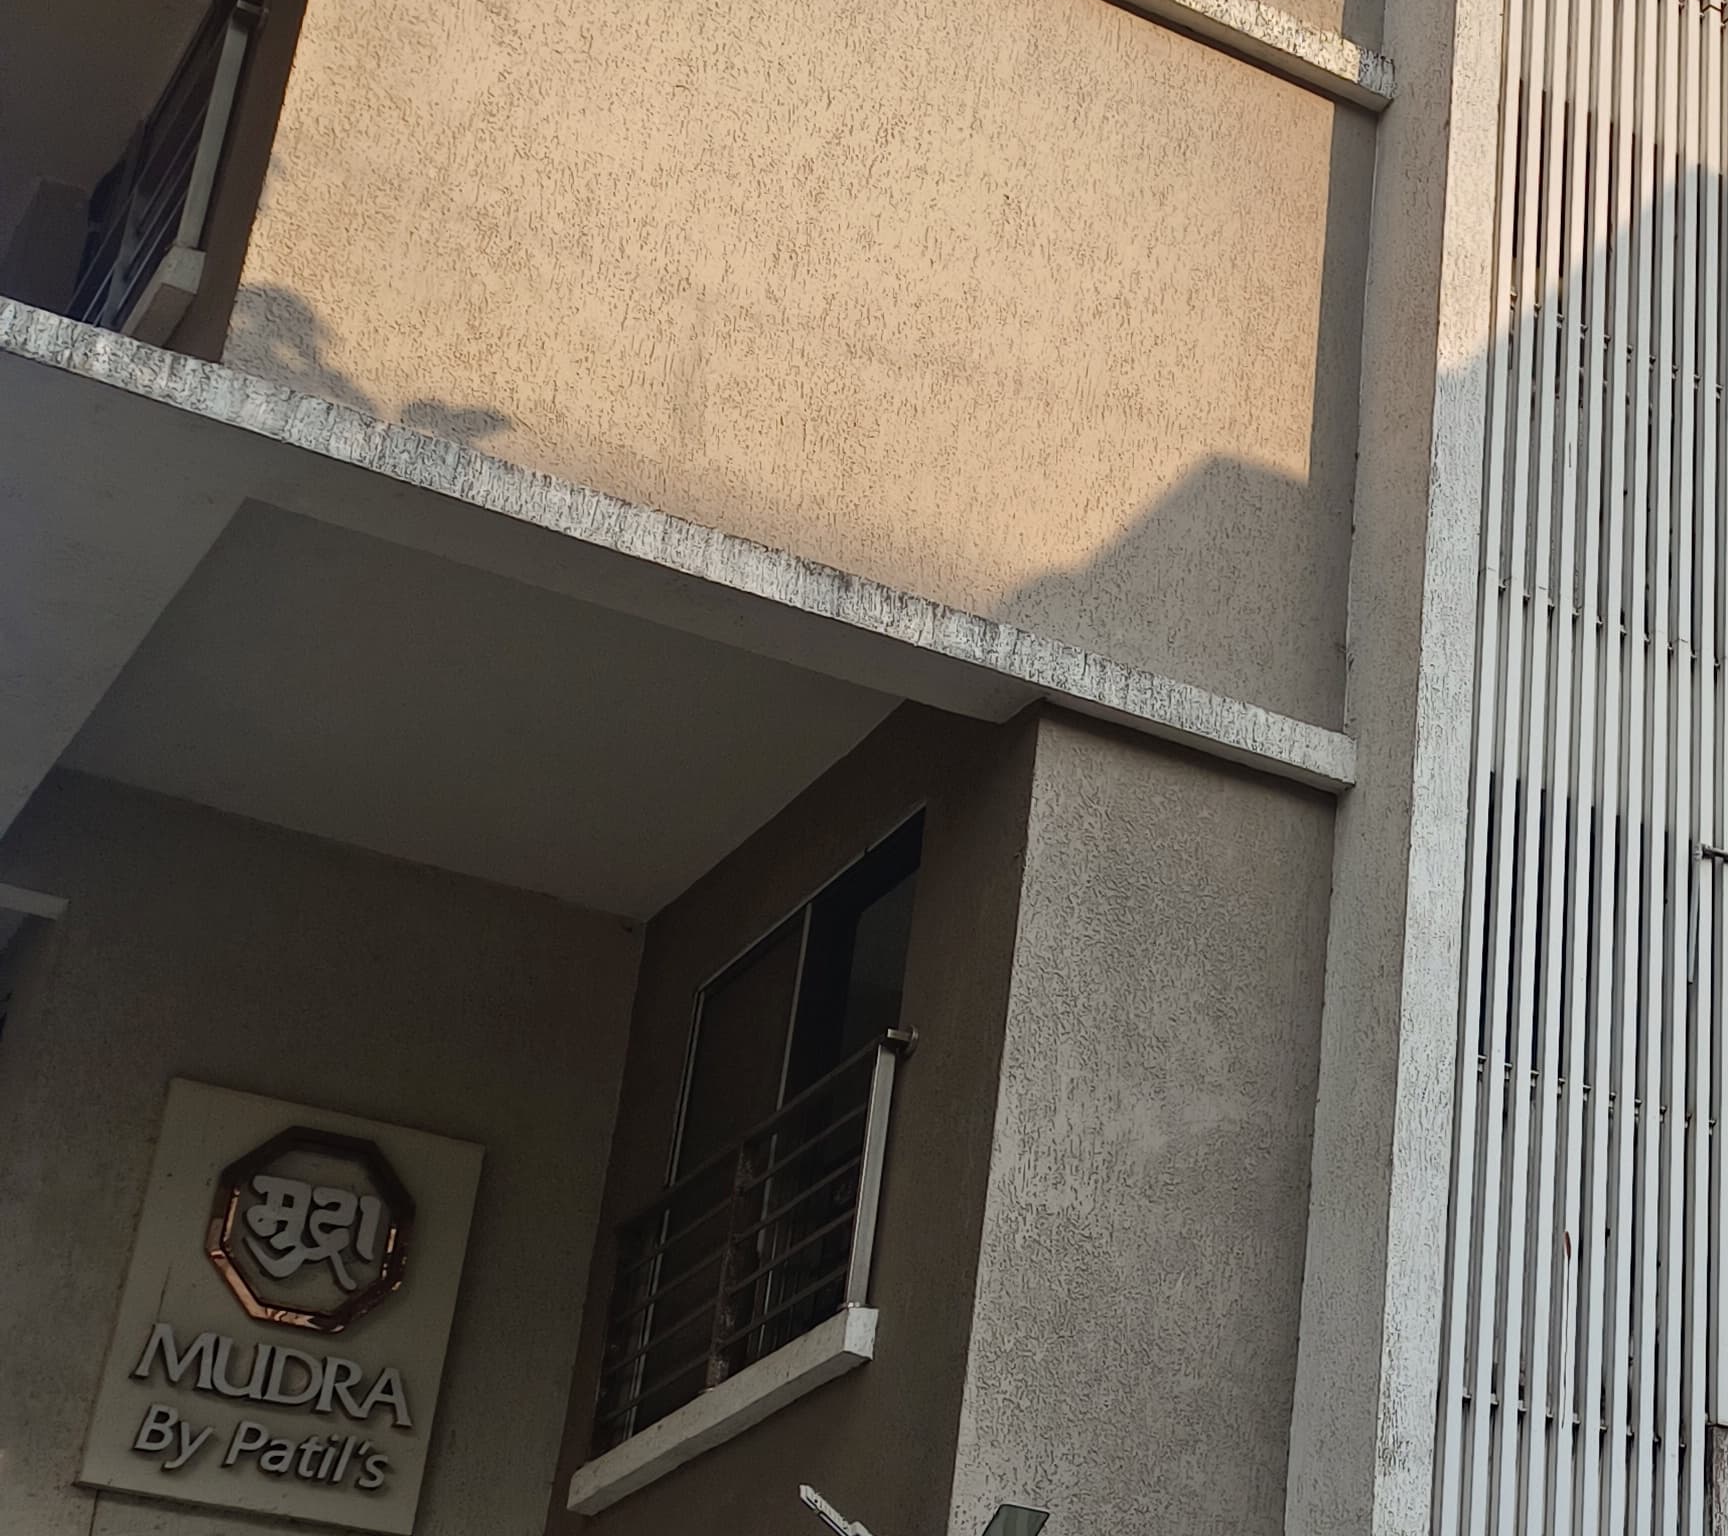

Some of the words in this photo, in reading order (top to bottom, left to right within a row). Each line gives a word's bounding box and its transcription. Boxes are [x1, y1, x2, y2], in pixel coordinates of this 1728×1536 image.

[242, 1174, 383, 1291] मुद्रा
[132, 1323, 413, 1428] MUDRA
[134, 1402, 213, 1470] By
[221, 1419, 390, 1491] Patil's
